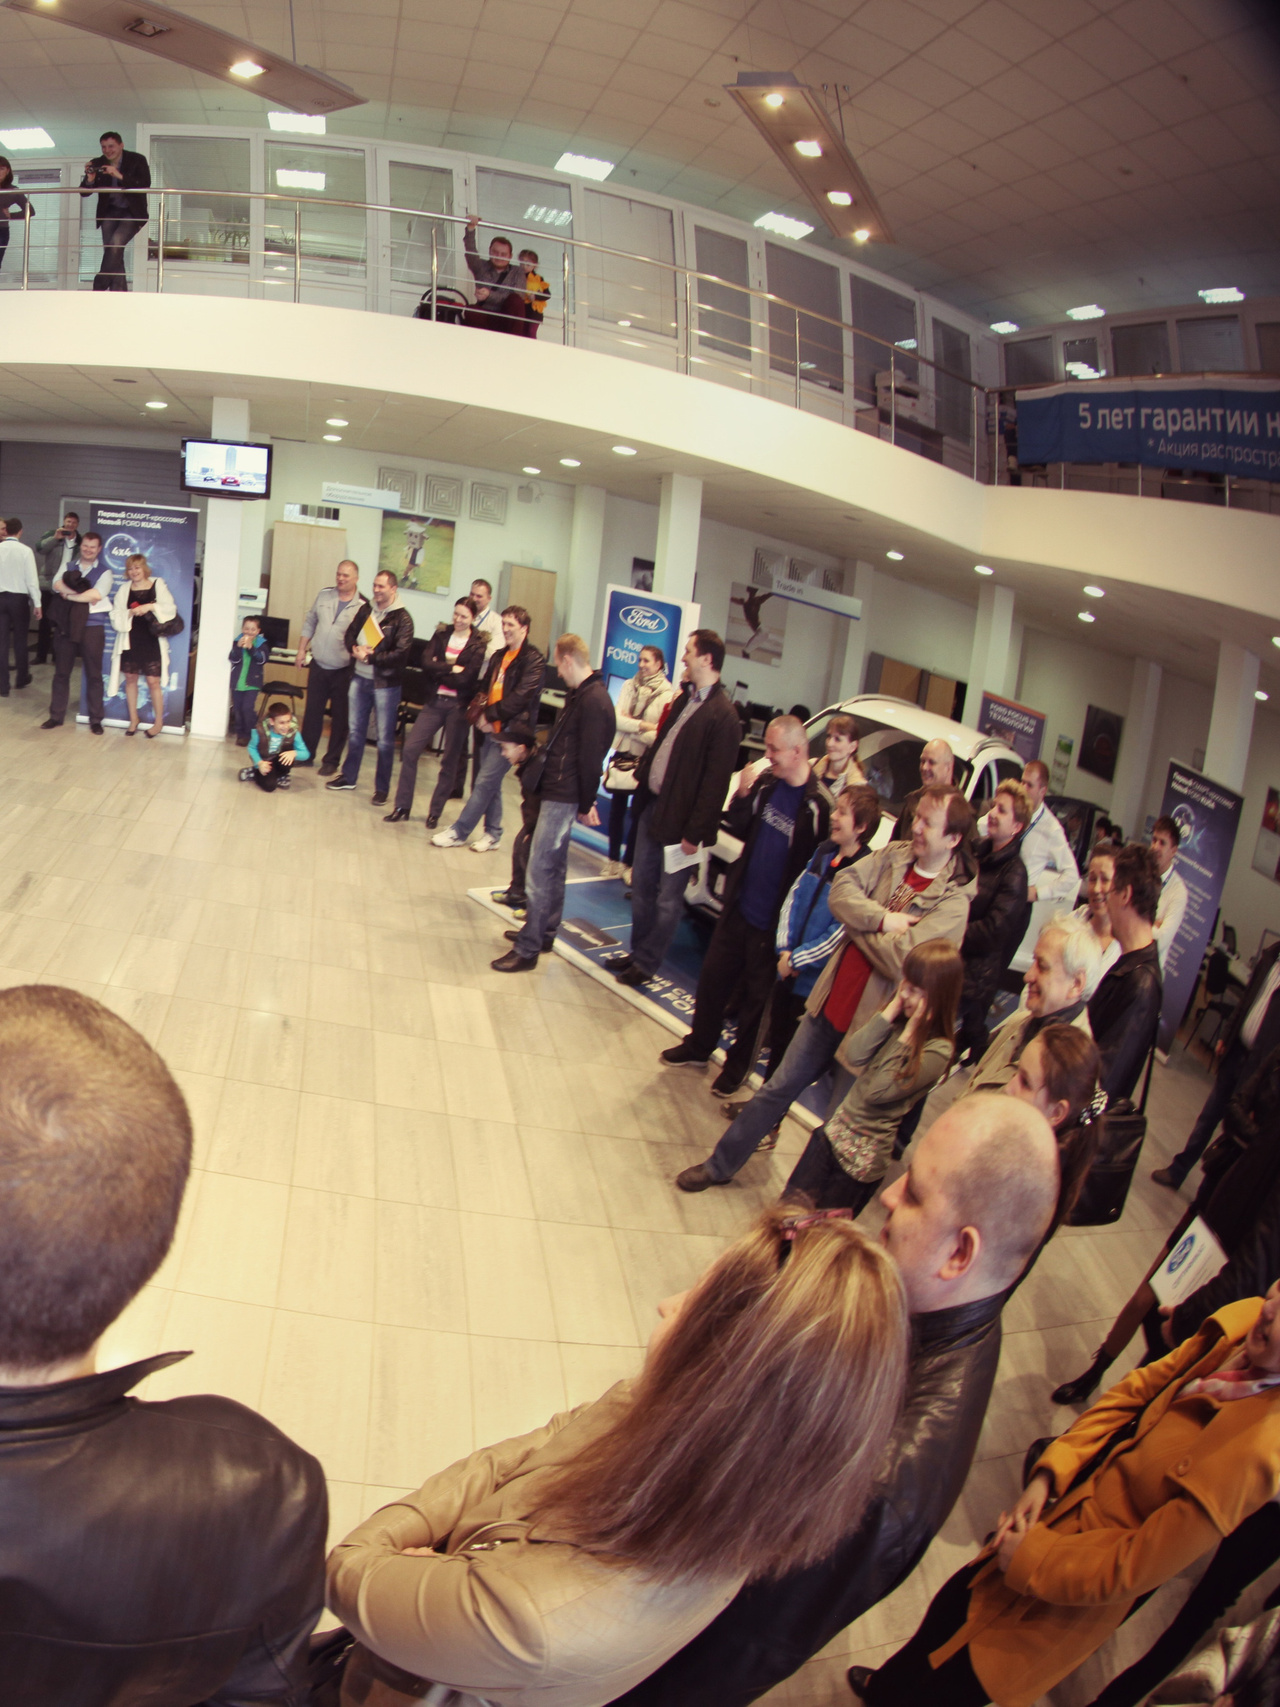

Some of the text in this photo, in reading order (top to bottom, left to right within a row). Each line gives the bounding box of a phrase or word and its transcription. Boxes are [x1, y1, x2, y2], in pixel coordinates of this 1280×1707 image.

[1078, 402, 1091, 429] 5
[1097, 407, 1136, 430] лет
[1140, 406, 1260, 437] гарантии
[1157, 437, 1199, 458] Акция
[97, 510, 126, 519] Первый
[97, 518, 162, 529] Новый FORD KUGA
[775, 579, 804, 596] Trade in
[627, 608, 661, 631] Ford
[606, 645, 638, 665] FORD
[989, 702, 1008, 716] FORD
[1007, 707, 1030, 724] FOCUS
